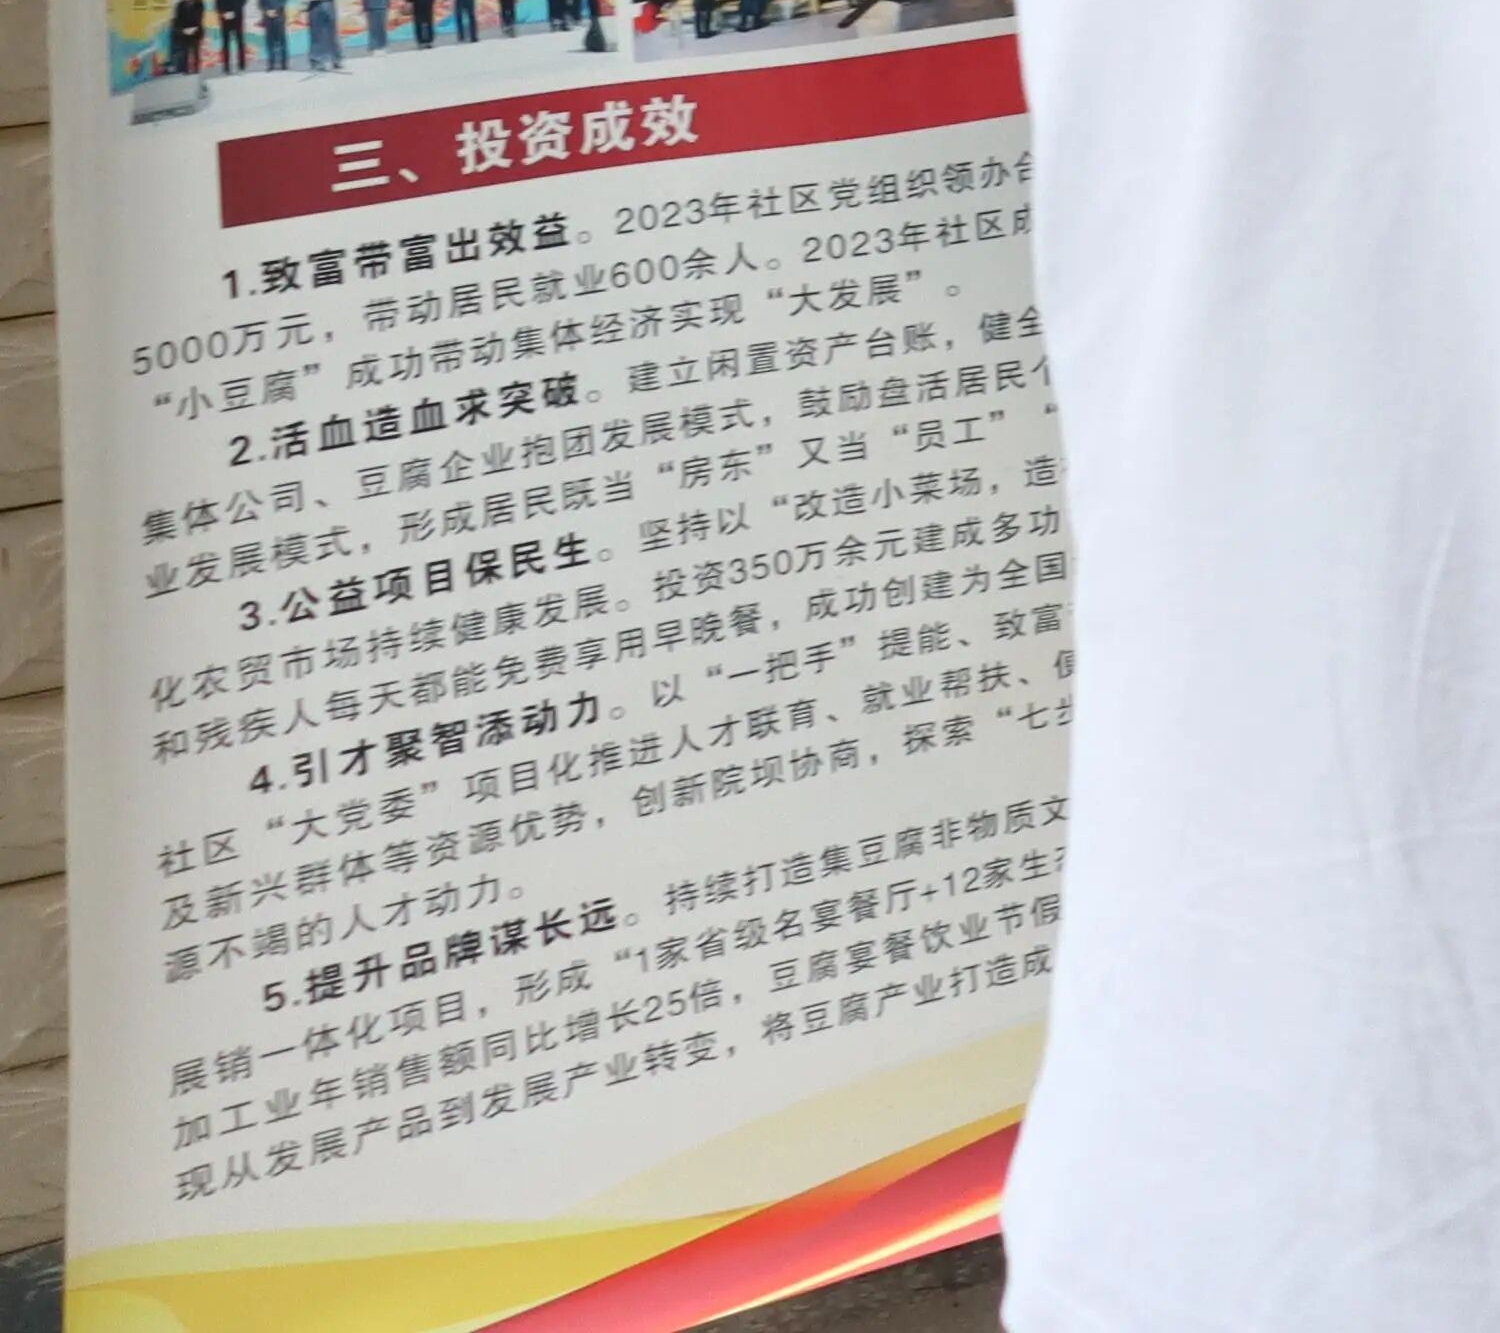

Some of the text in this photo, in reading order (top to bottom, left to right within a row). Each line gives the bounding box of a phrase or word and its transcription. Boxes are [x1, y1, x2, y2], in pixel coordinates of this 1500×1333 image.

[331, 95, 698, 194] 三、投资成效
[164, 872, 525, 984] 源不竭的人才动力。
